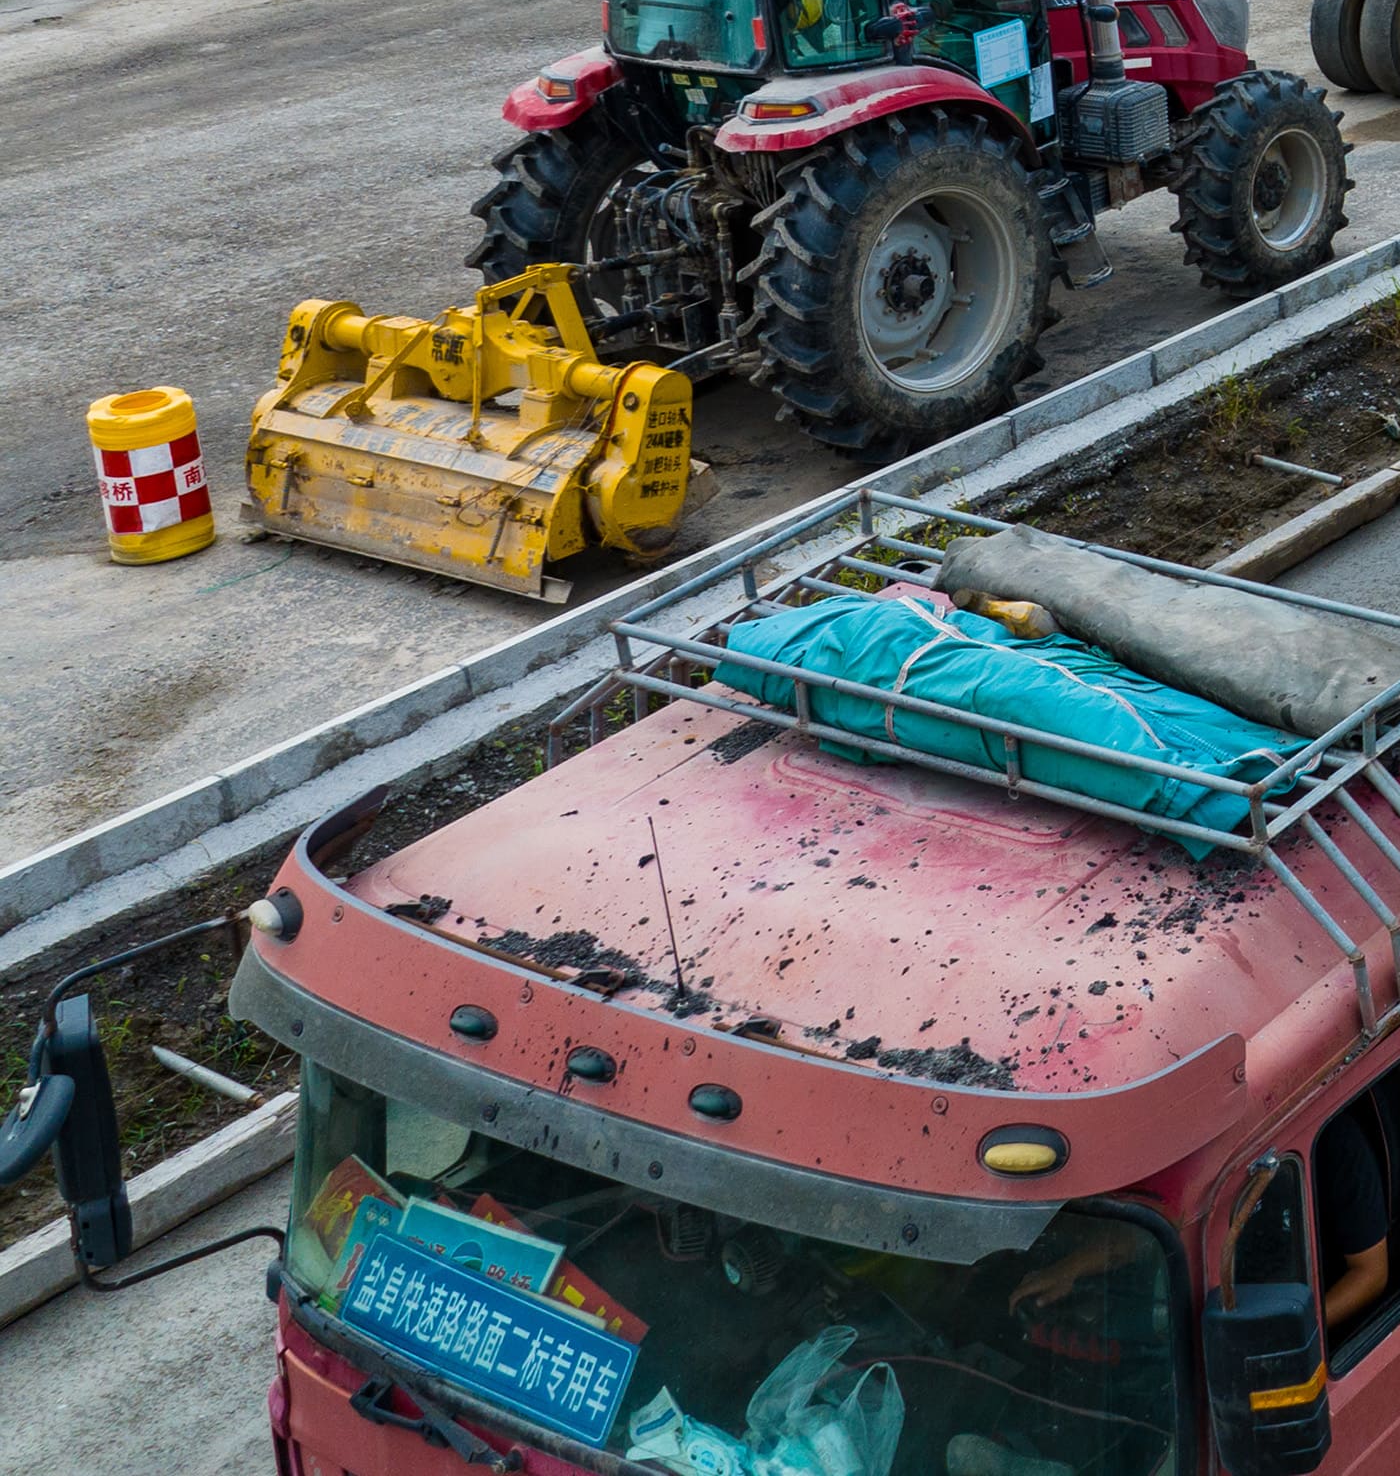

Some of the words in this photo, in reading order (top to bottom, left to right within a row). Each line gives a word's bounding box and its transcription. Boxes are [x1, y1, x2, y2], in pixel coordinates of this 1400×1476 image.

[353, 1255, 618, 1421] 盐阜快速路路面二标专用车
